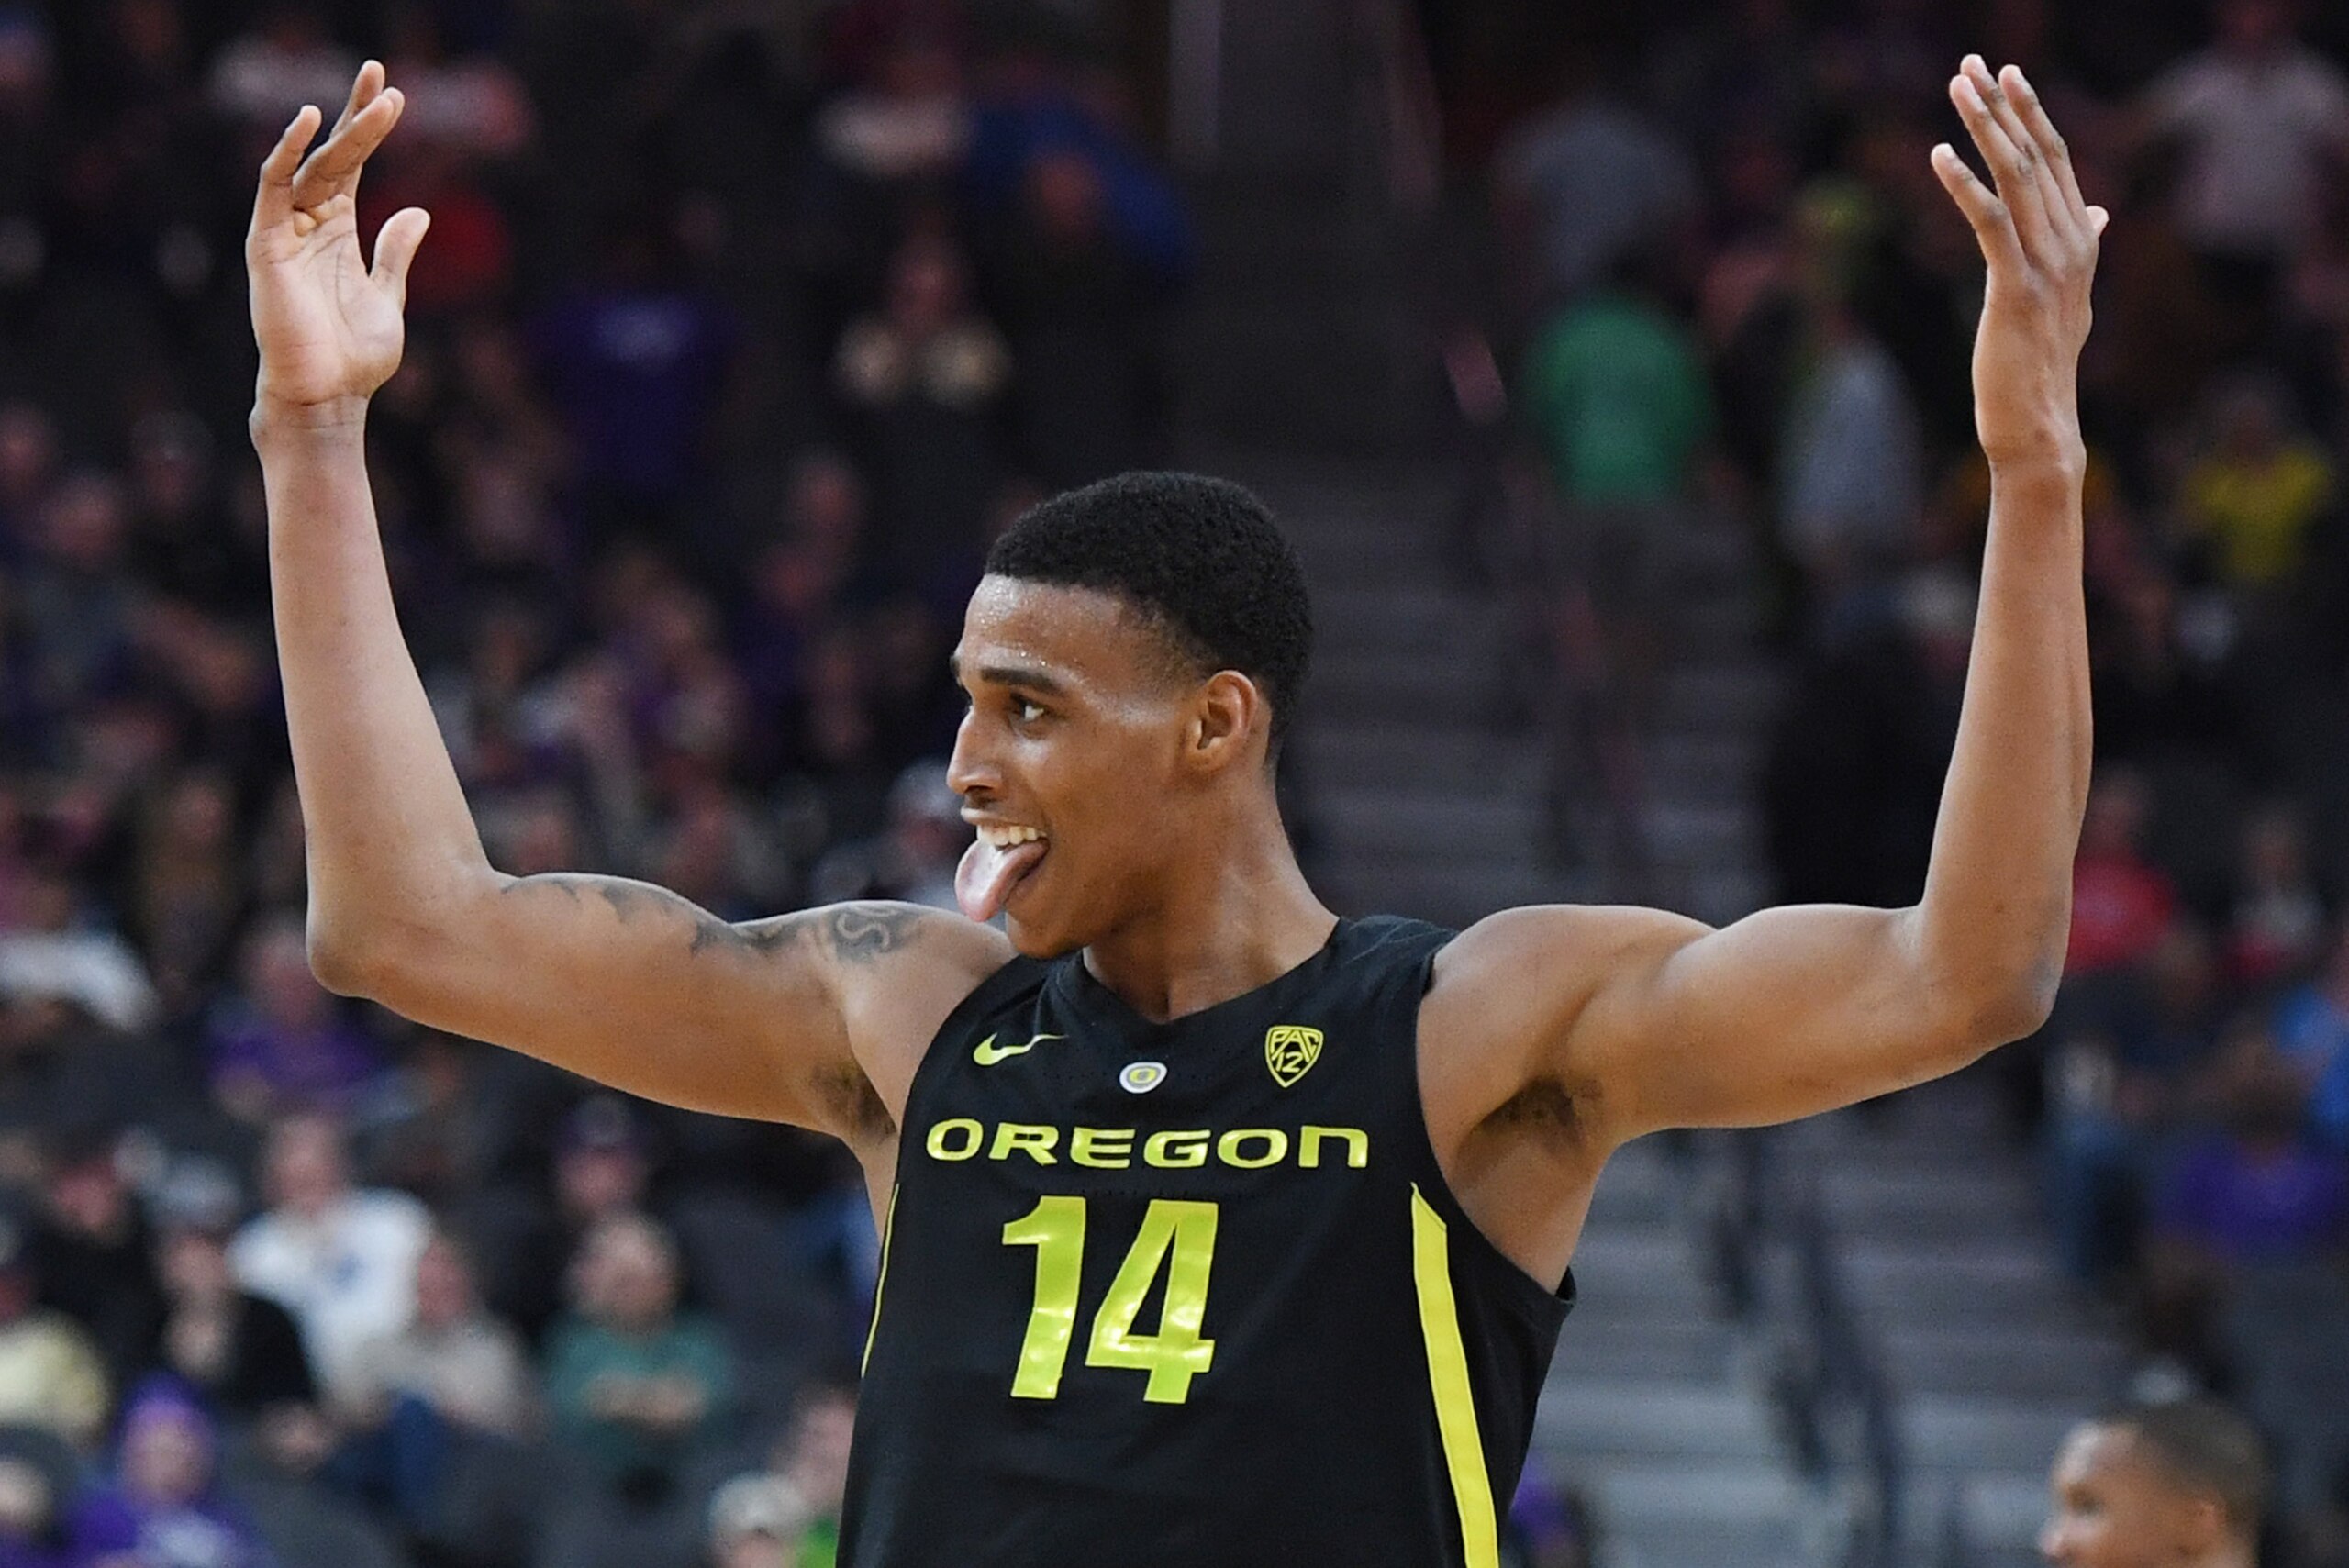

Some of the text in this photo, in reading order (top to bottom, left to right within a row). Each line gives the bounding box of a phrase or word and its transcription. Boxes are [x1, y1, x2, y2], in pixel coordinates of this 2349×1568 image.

[1270, 1029, 1319, 1062] PAC
[1275, 1051, 1303, 1073] 12
[926, 1118, 1368, 1169] OREGON
[1002, 1195, 1219, 1404] 14
